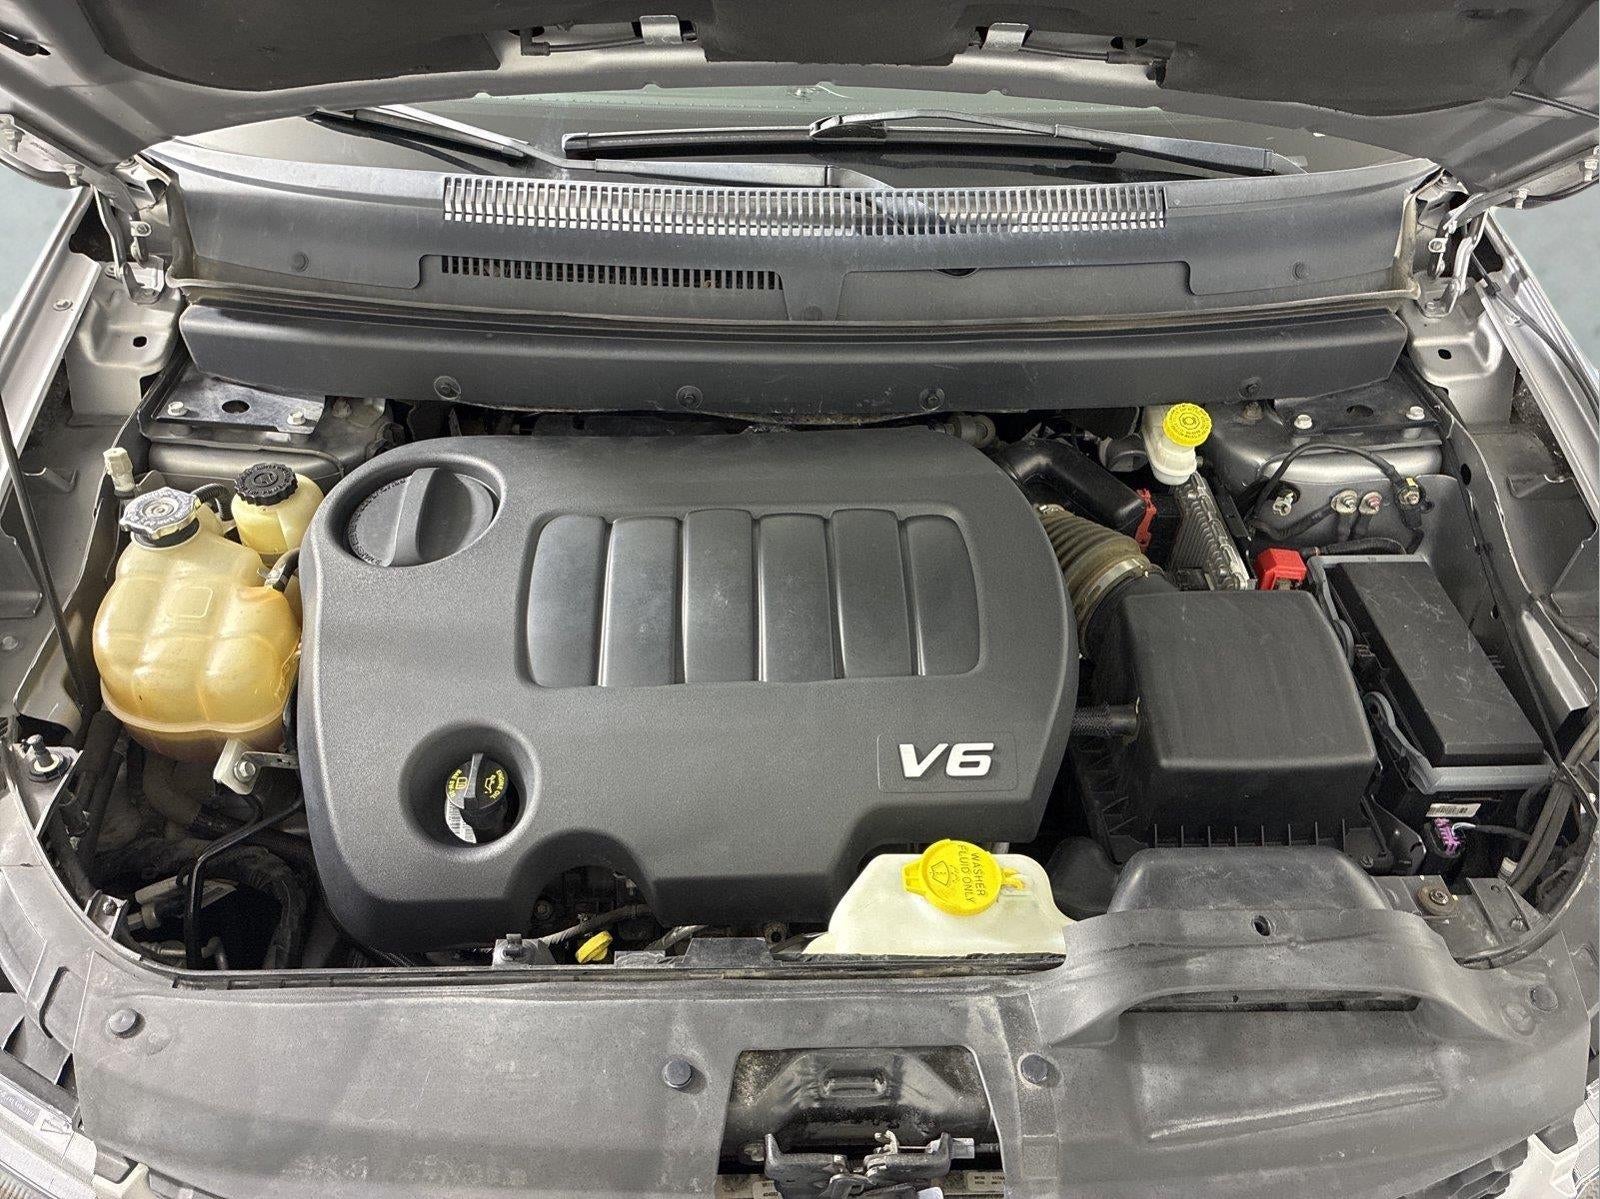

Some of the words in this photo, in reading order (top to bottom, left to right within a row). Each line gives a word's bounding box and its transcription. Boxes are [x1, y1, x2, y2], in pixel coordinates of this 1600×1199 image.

[899, 742, 994, 777] V6
[489, 790, 501, 799] OIL
[496, 769, 505, 790] ENGINE
[957, 843, 970, 877] FLUID
[970, 852, 987, 897] WASHER
[961, 876, 976, 903] ONLY
